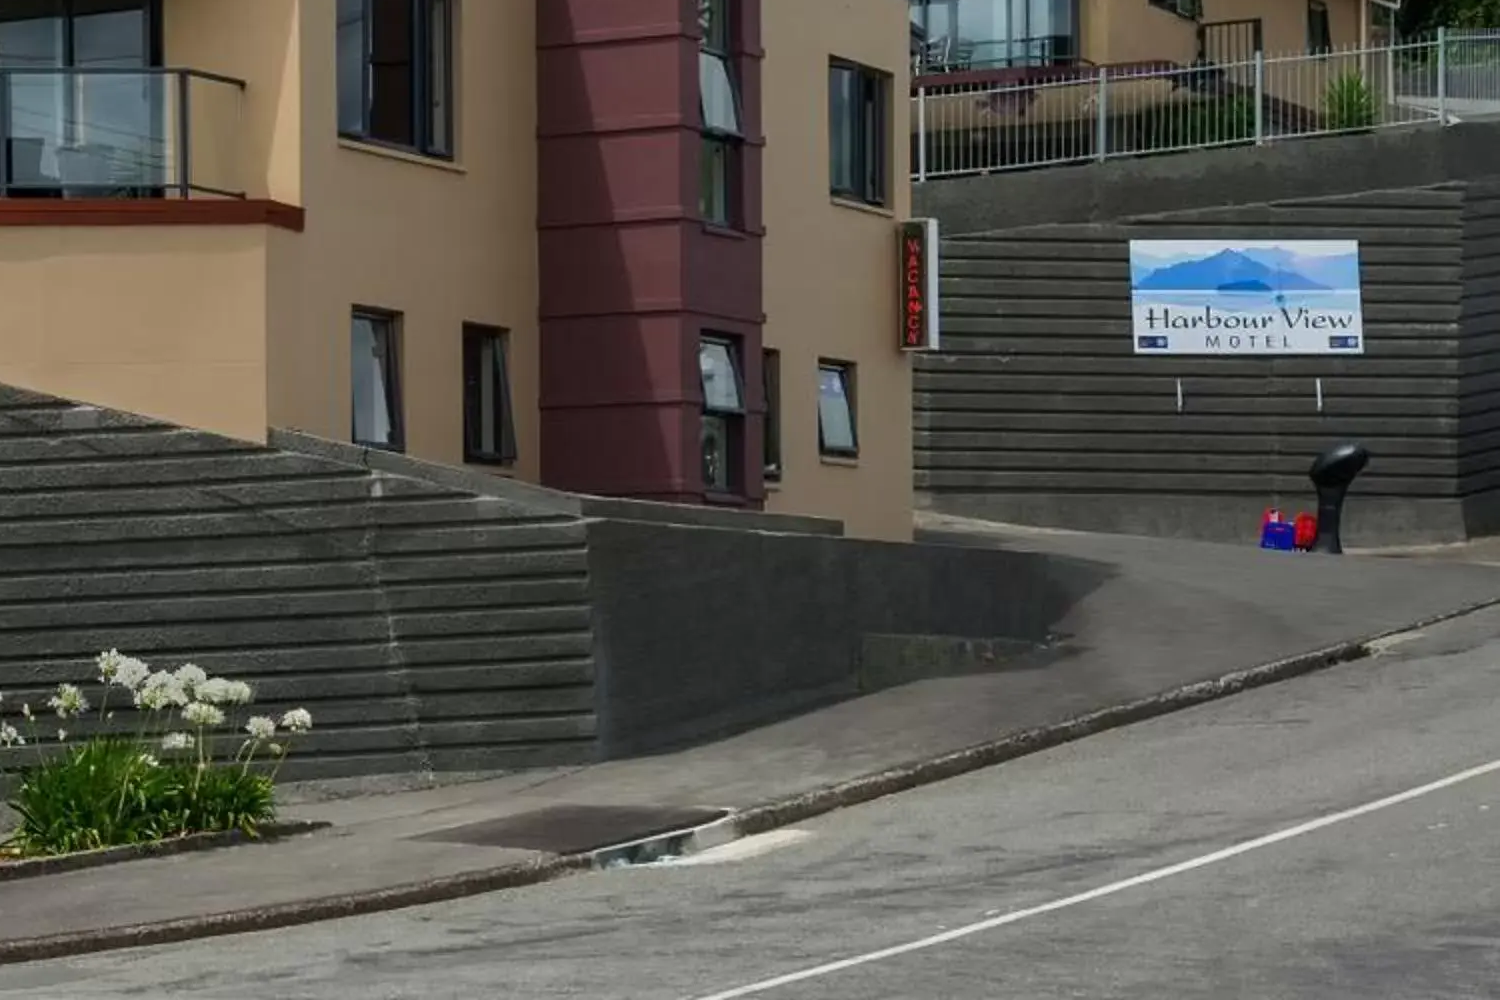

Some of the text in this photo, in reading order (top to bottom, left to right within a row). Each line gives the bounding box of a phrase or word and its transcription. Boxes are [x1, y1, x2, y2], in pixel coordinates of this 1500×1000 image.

[1145, 305, 1352, 330] Harbour View
[1205, 335, 1292, 349] MOTEL
